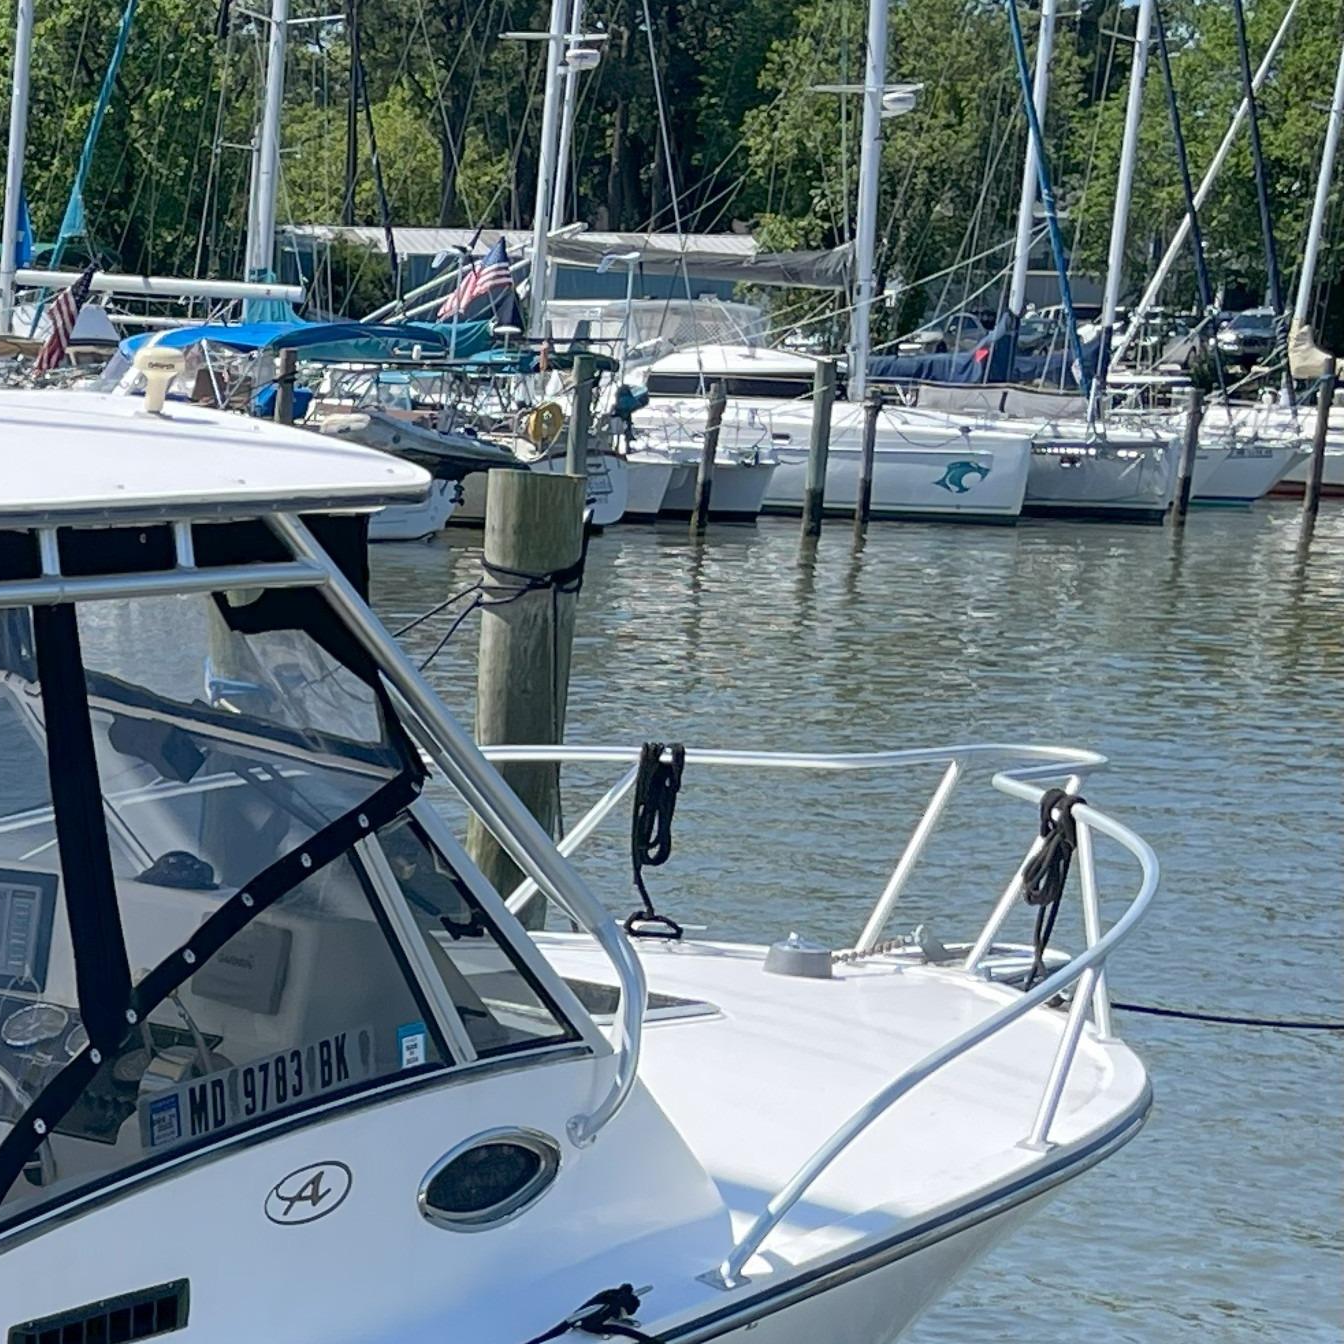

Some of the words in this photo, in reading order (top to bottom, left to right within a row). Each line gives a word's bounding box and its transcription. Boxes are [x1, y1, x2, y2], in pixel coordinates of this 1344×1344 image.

[188, 1079, 226, 1136] MD
[243, 1050, 304, 1116] 9783
[319, 1032, 350, 1089] BK
